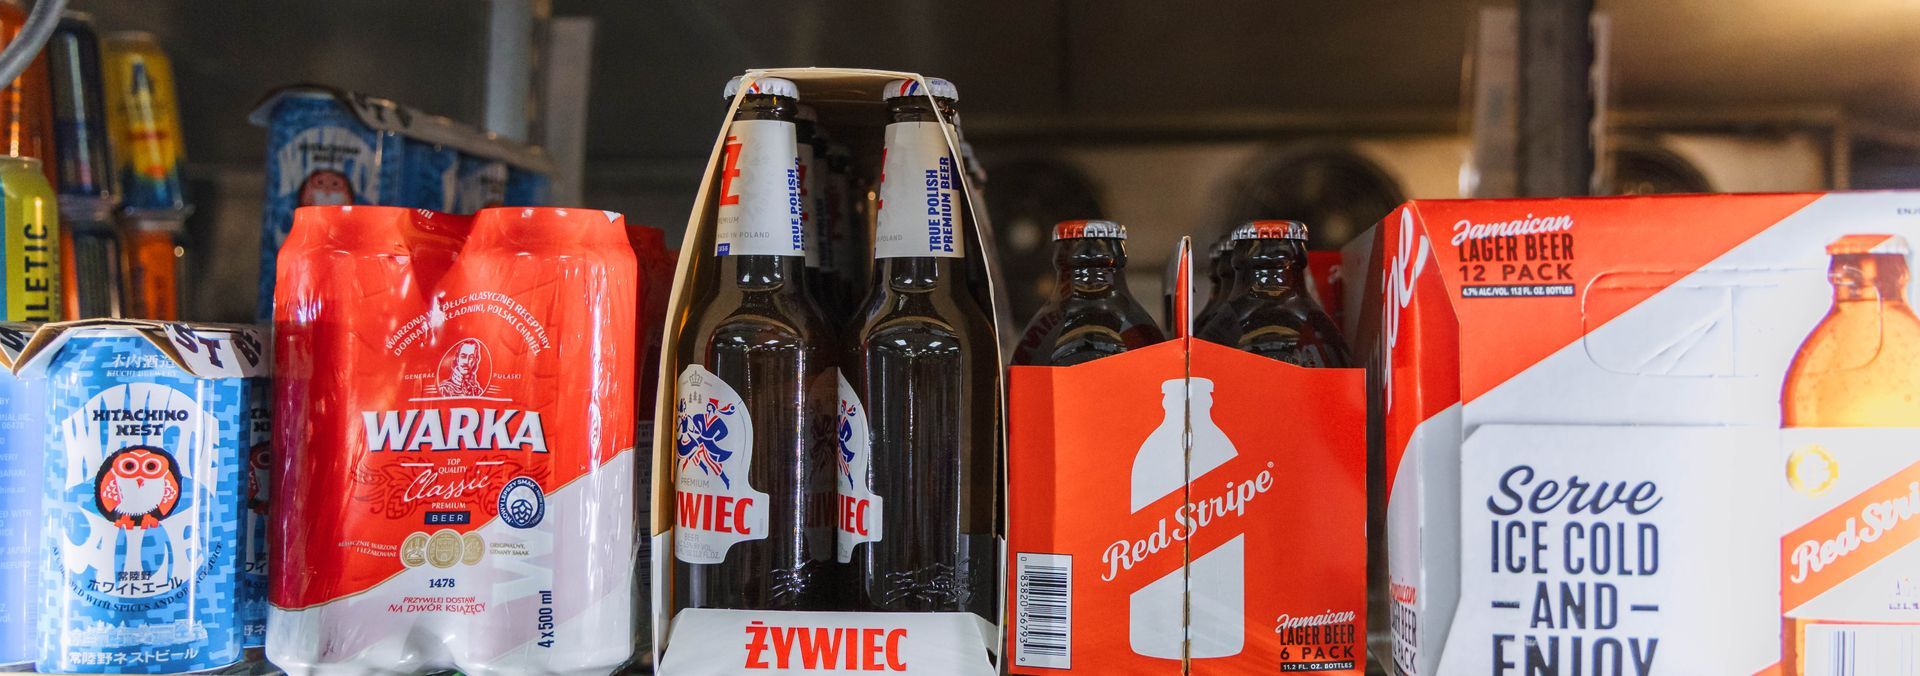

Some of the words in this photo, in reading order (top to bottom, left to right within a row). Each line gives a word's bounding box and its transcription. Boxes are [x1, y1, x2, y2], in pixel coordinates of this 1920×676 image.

[939, 156, 950, 191] BEER
[786, 168, 799, 216] POLISH
[925, 169, 939, 215] POLISH
[739, 231, 770, 239] POLAND
[792, 218, 801, 251] TRUE
[929, 215, 942, 252] TRUE
[942, 194, 954, 253] PREMIUM
[1451, 212, 1573, 246] Jamaican
[1458, 234, 1518, 263] LAGER
[1525, 233, 1575, 262] BEER
[1458, 264, 1486, 282] 12
[1502, 263, 1574, 281] PACK
[1545, 285, 1574, 296] BOTTLES
[385, 314, 426, 350] WARZONA
[468, 290, 517, 310] KLASYCZNEJ
[514, 304, 552, 350] RECEPTURY
[394, 318, 434, 357] DOBRAN
[434, 303, 486, 325] KŁADNIKI,
[486, 304, 517, 325] POLSKI
[515, 323, 542, 357] CHMIEL
[92, 408, 190, 423] HITACHINO
[115, 423, 164, 437] NEST
[361, 407, 550, 454] WARKA
[438, 465, 468, 475] QUALITY
[446, 458, 461, 466] TOP
[403, 468, 491, 503] Classic
[680, 476, 711, 488] PREMIUM
[1486, 464, 1664, 516] Serve
[431, 502, 466, 510] PREMIUM
[499, 503, 513, 524] NOWY
[516, 478, 536, 489] SMAK
[431, 514, 465, 523] BEER
[1101, 517, 1172, 582] Red
[1171, 467, 1274, 542] Stripe
[1490, 519, 1549, 574] ICE
[1562, 520, 1660, 576] COLD
[1790, 517, 1861, 584] Red
[86, 594, 111, 611] WITH
[113, 602, 151, 613] SPICES
[153, 596, 175, 610] AND
[208, 541, 224, 570] JUICE
[87, 576, 183, 596] ホワイトエール
[429, 578, 456, 589] 1478
[402, 596, 444, 604] PRZYWILEJ
[445, 596, 476, 604] DOSTAW
[539, 590, 553, 606] ml
[1020, 575, 1029, 608] 83820
[1529, 580, 1619, 630] AND
[387, 603, 403, 613] NA
[406, 602, 442, 613] DWÓR
[445, 602, 486, 616] KSIĄŻĘCY
[538, 607, 554, 632] 500
[1275, 609, 1356, 634] Jamaican
[541, 631, 554, 639] x
[1020, 611, 1029, 644] 56793
[1280, 625, 1320, 646] LAGER
[1324, 623, 1355, 645] BEER
[68, 647, 199, 667] 常陸野ネストビール
[537, 639, 555, 649] 4
[744, 620, 908, 672] ŻYWIEC
[1280, 647, 1290, 660] 6
[1301, 646, 1356, 660] PACK
[1490, 633, 1661, 676] ENJOY
[1324, 662, 1353, 670] BOTTLES
